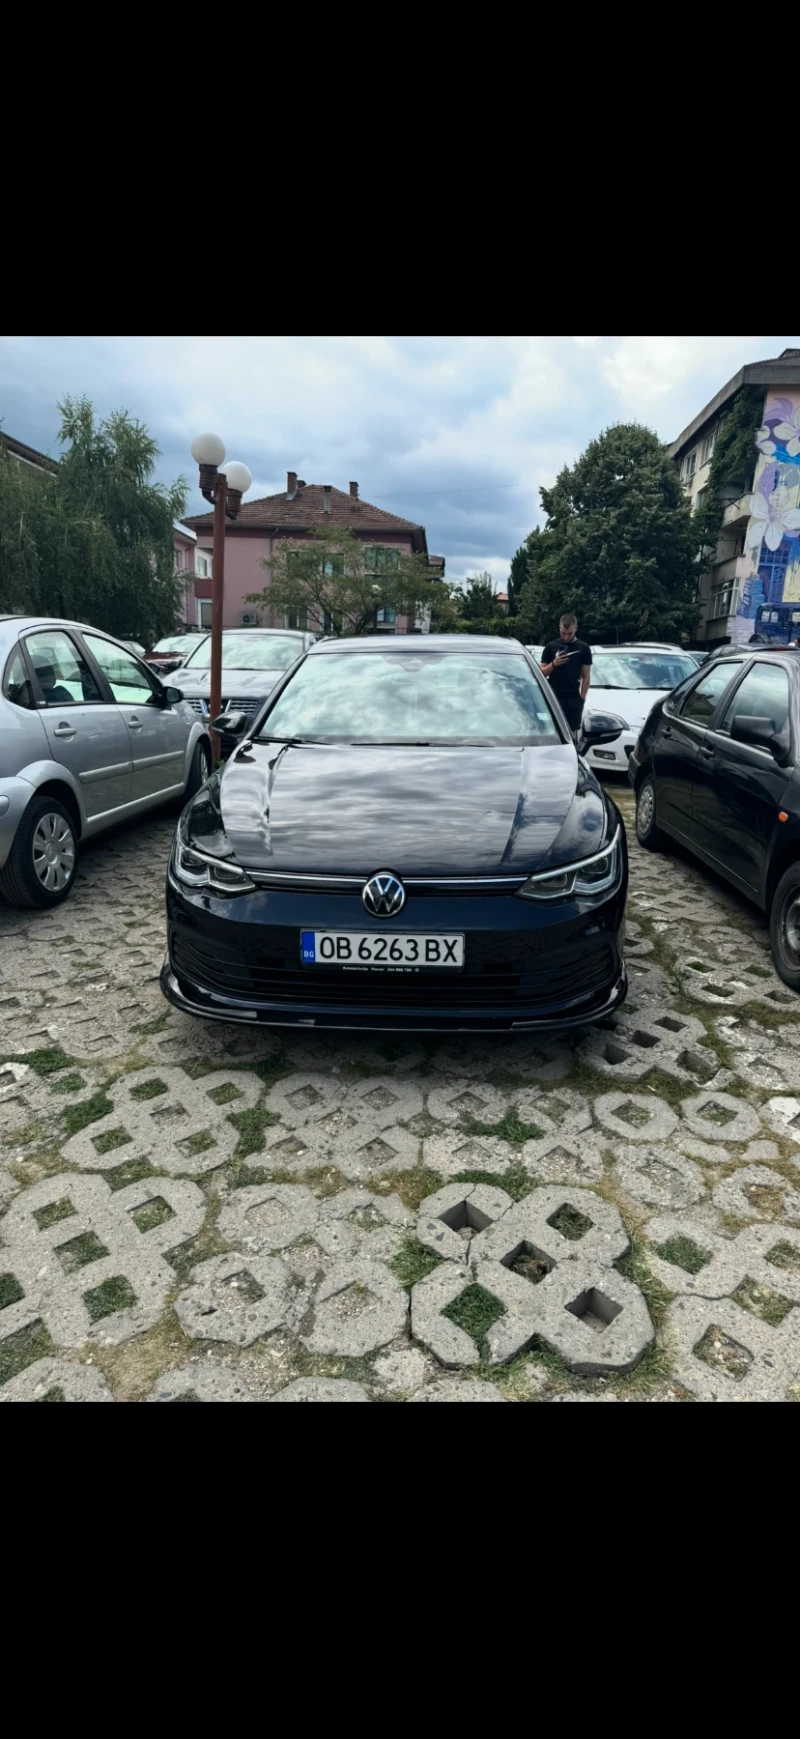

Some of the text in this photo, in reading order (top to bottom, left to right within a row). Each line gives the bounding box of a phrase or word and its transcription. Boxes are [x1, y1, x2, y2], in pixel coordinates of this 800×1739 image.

[303, 950, 315, 958] BG
[320, 936, 458, 963] OB 6263 BX
